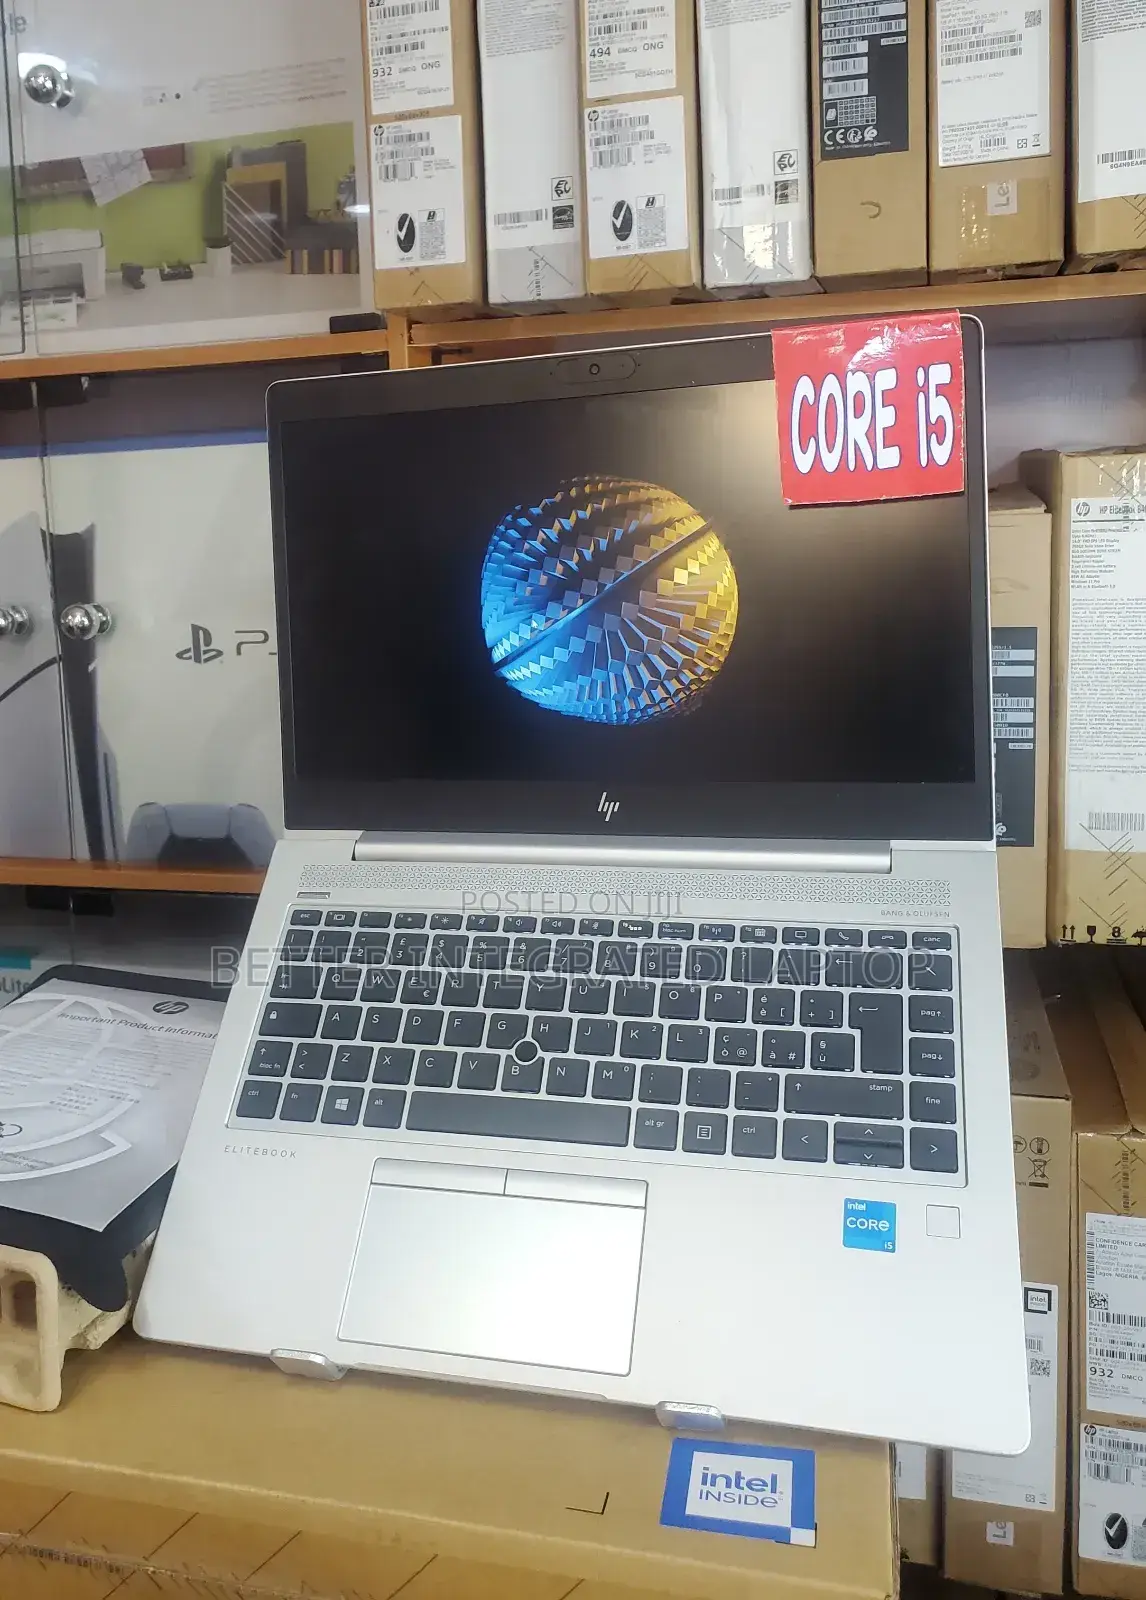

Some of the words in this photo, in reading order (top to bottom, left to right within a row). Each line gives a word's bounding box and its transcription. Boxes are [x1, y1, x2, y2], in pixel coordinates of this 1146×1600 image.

[590, 47, 611, 58] 494
[643, 42, 664, 51] ONG
[373, 67, 392, 77] 932
[421, 61, 441, 70] ONG
[791, 367, 901, 474] CORE
[916, 363, 954, 468] i5
[1100, 506, 1107, 514] HP
[1112, 927, 1121, 937] 8
[520, 942, 526, 950] &
[396, 950, 403, 958] 3
[477, 954, 483, 962] 5
[648, 962, 656, 970] 9
[331, 973, 340, 983] Q
[372, 975, 383, 984] W
[451, 980, 459, 988] R
[493, 981, 500, 989] T
[536, 984, 545, 992] Y
[579, 986, 588, 994] U
[669, 991, 679, 1000] O
[714, 994, 722, 1002] P
[332, 1012, 340, 1021] A
[372, 1015, 379, 1023] S
[412, 1017, 421, 1025] D
[58, 1013, 116, 1025] Important
[117, 1019, 164, 1032] Product
[454, 1019, 462, 1027] F
[497, 1021, 507, 1030] G
[540, 1024, 548, 1032] H
[584, 1027, 591, 1036] J
[630, 1030, 639, 1039] K
[676, 1033, 683, 1042] L
[737, 1048, 747, 1057] @
[788, 1052, 796, 1060] #
[341, 1053, 350, 1062] Z
[382, 1056, 392, 1064] X
[425, 1058, 434, 1067] C
[469, 1061, 478, 1070] V
[511, 1066, 520, 1075] B
[556, 1067, 566, 1076] N
[603, 1070, 613, 1079] M
[869, 1084, 893, 1092] stamp
[224, 1145, 297, 1158] ELITEBOOK
[847, 1201, 866, 1211] intel
[884, 1242, 893, 1250] i5
[1096, 1238, 1132, 1246] CONFIDENCE
[1090, 1367, 1114, 1378] 932
[701, 1467, 778, 1494] intel
